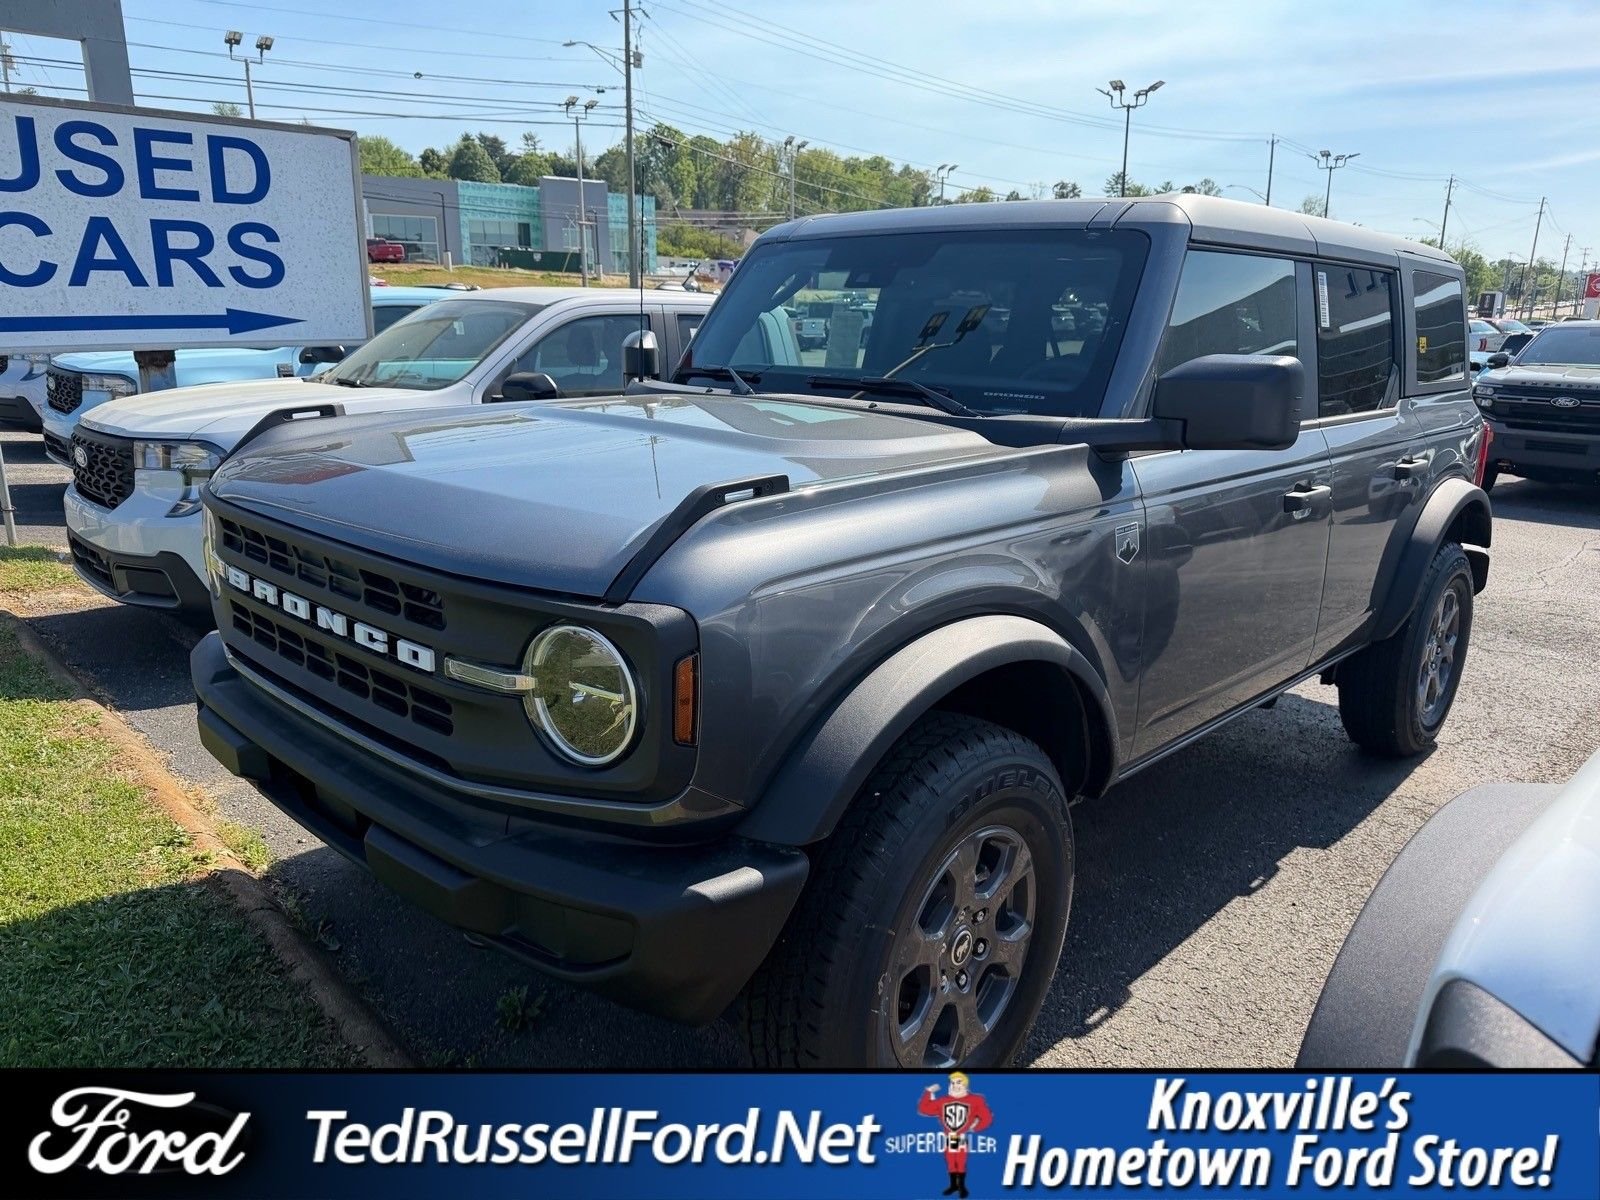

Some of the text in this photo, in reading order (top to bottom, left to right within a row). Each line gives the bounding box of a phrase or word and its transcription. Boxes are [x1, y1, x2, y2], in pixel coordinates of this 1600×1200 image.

[0, 211, 286, 289] CARS
[1554, 397, 1577, 407] Ford
[227, 565, 436, 673] BRONCO
